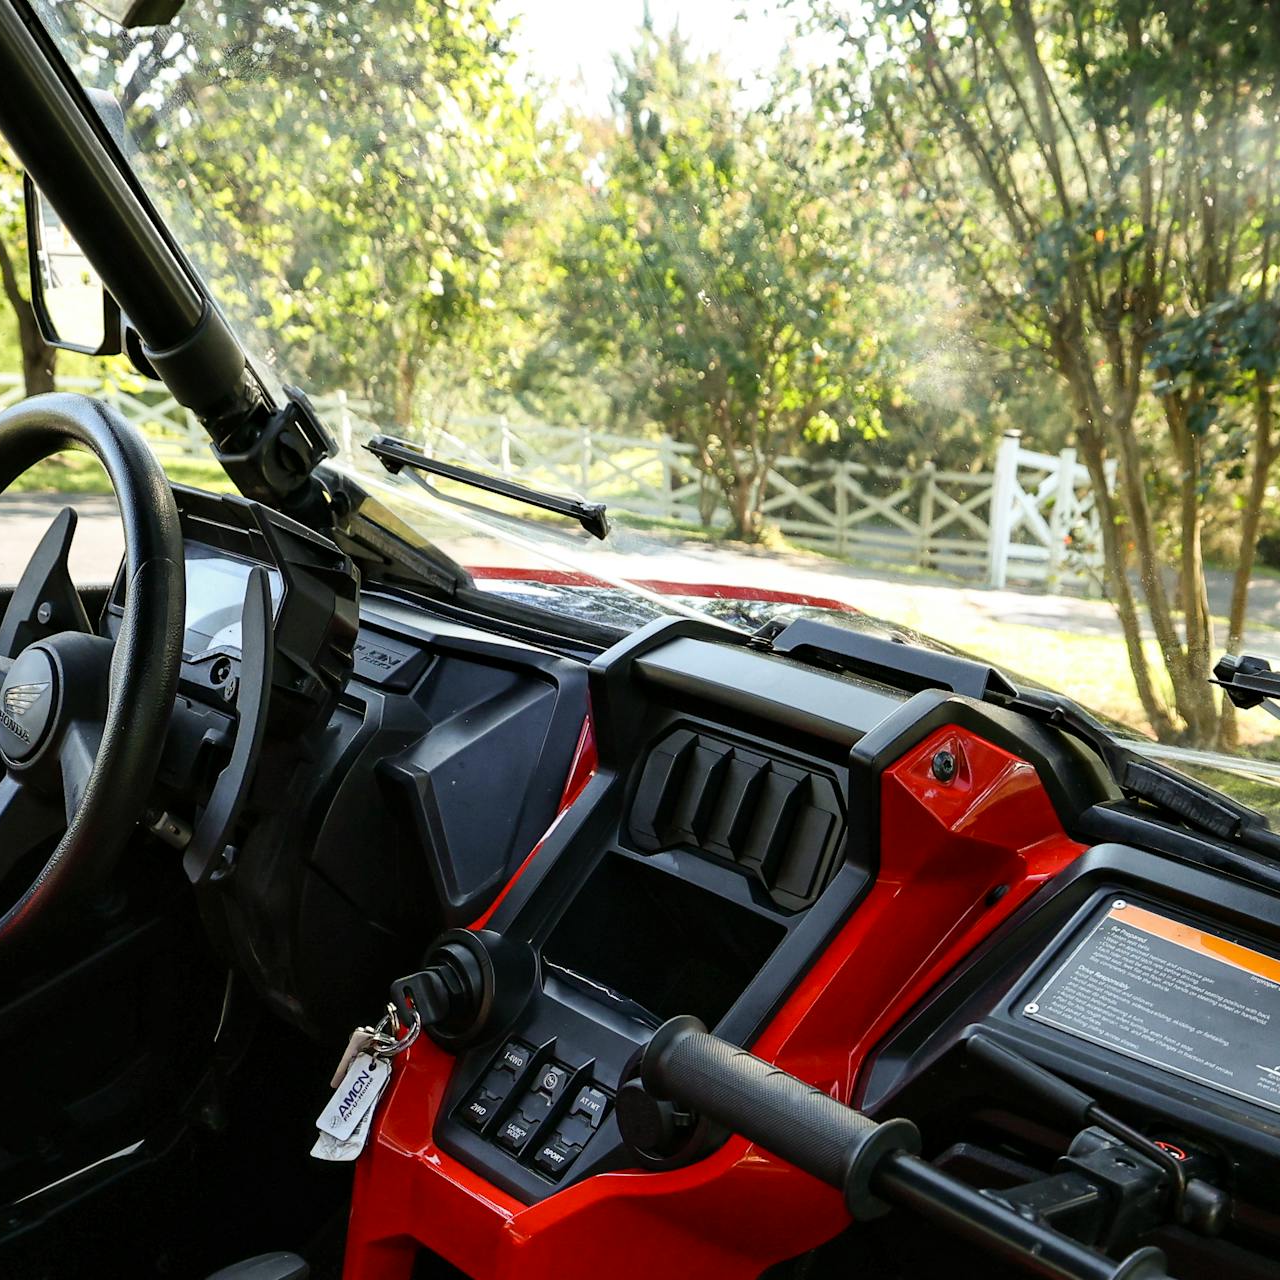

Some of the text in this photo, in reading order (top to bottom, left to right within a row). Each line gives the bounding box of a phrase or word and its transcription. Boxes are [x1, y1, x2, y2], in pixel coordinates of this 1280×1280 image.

[1118, 929, 1148, 944] Prepared
[1078, 965, 1131, 991] Drive Responsibly
[1250, 975, 1280, 990] Improper
[338, 1070, 370, 1118] AMCN
[343, 1077, 373, 1122] Fly-U-Home
[470, 1102, 487, 1116] 2WD
[506, 1129, 521, 1140] MODE
[508, 1123, 527, 1137] LAUNCH
[543, 1148, 565, 1164] SPORT
